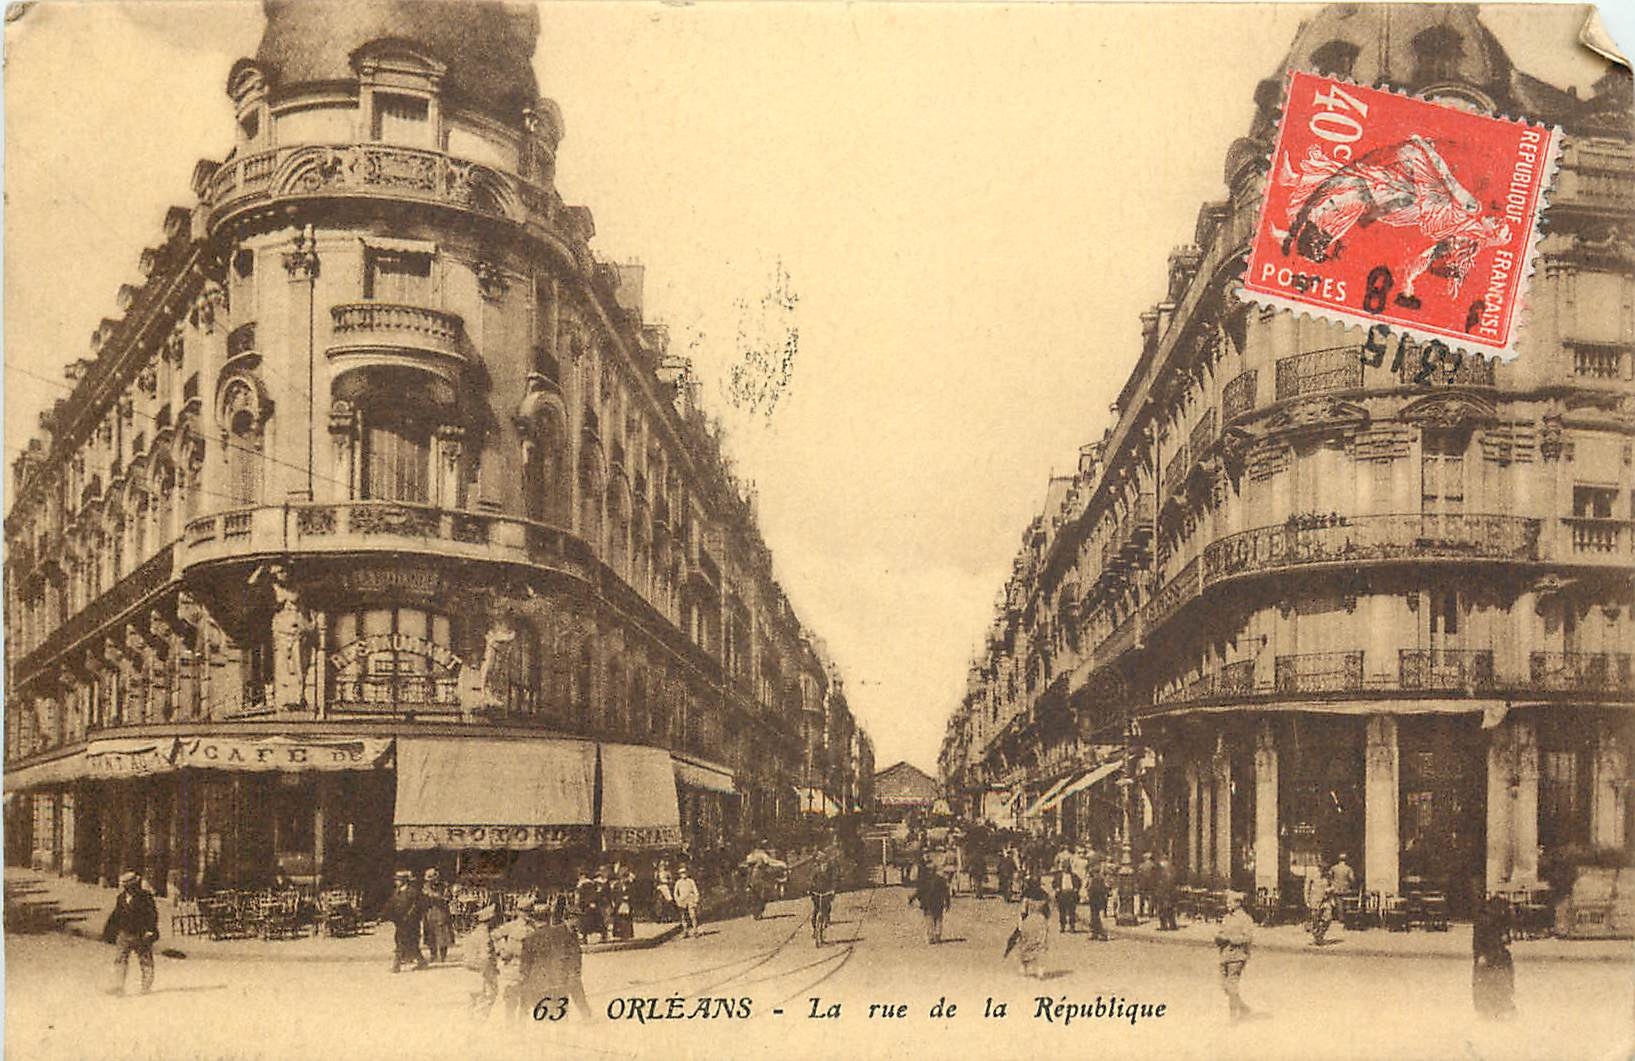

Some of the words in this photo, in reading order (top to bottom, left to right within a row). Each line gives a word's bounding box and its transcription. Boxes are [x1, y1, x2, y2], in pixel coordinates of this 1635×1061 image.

[1505, 130, 1540, 224] REPUBLIQUE
[1261, 263, 1347, 302] POSTES
[409, 830, 438, 843] LA
[449, 828, 586, 844] ROTOND
